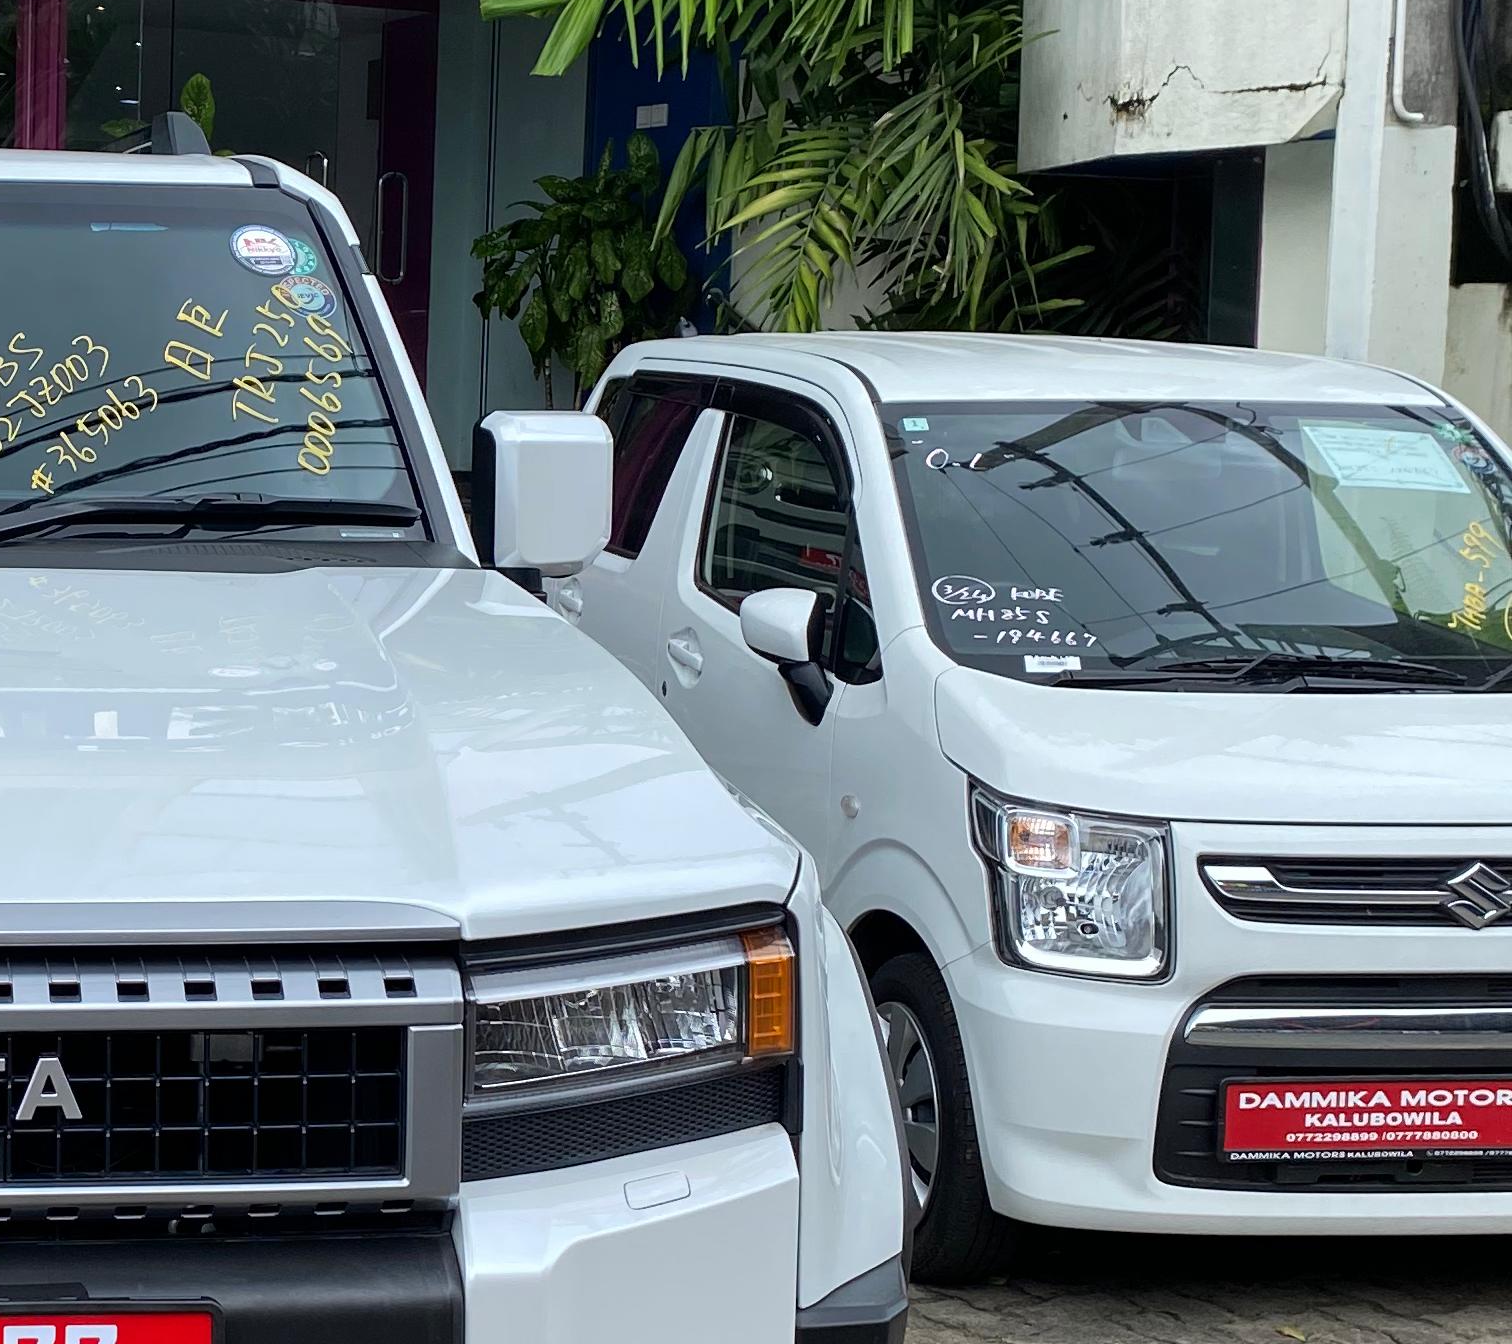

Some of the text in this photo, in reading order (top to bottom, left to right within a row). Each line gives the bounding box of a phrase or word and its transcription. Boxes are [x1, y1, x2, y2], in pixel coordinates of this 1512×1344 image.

[1239, 1090, 1392, 1109] DAMMIKA
[1305, 1111, 1463, 1127] KALUBOWILA
[1230, 1152, 1291, 1160] DAMMIKA
[1293, 1151, 1346, 1159] MOTORS
